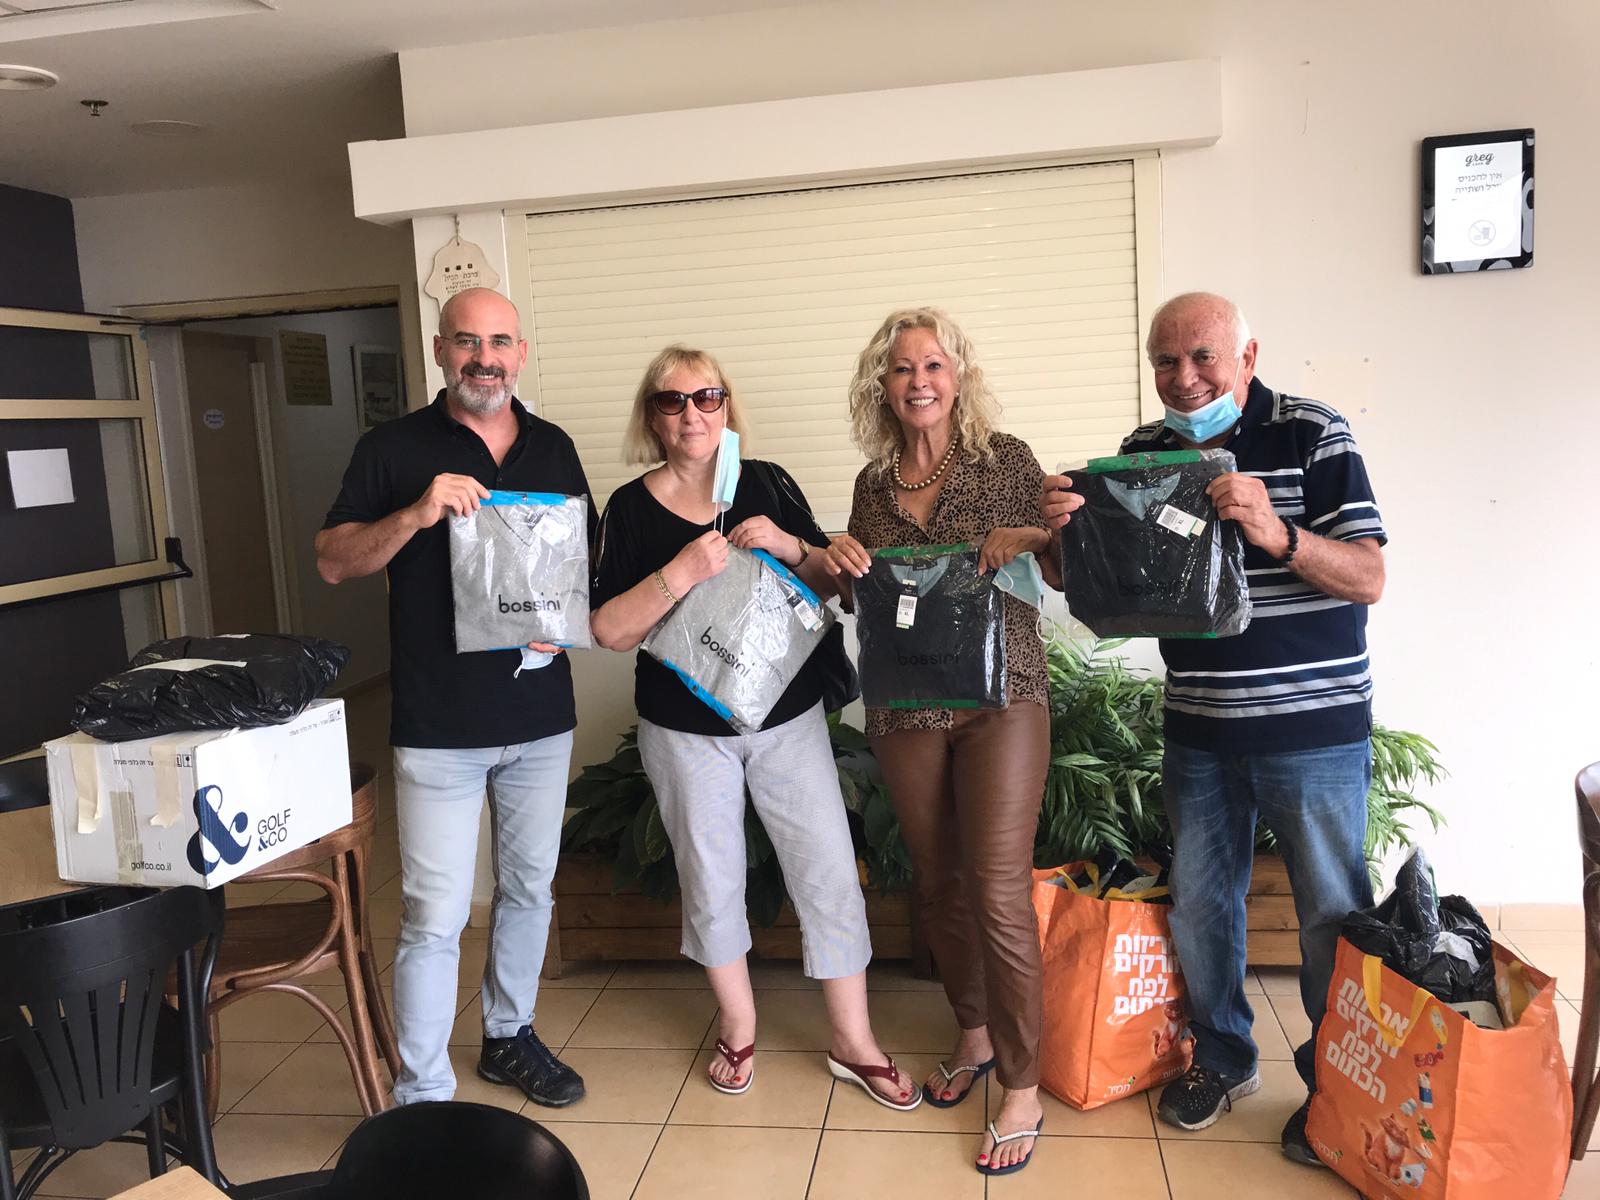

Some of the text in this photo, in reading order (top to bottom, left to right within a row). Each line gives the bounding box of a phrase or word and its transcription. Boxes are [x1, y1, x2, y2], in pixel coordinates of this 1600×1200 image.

[1465, 153, 1494, 167] greg
[498, 591, 561, 614] bossini
[700, 625, 755, 678] bossini
[897, 646, 960, 666] bossini
[257, 808, 291, 835] GOLF
[1128, 973, 1168, 997] לפח
[1113, 996, 1175, 1015] תום
[1340, 1030, 1382, 1073] לפח
[1325, 1040, 1387, 1105] הכתום
